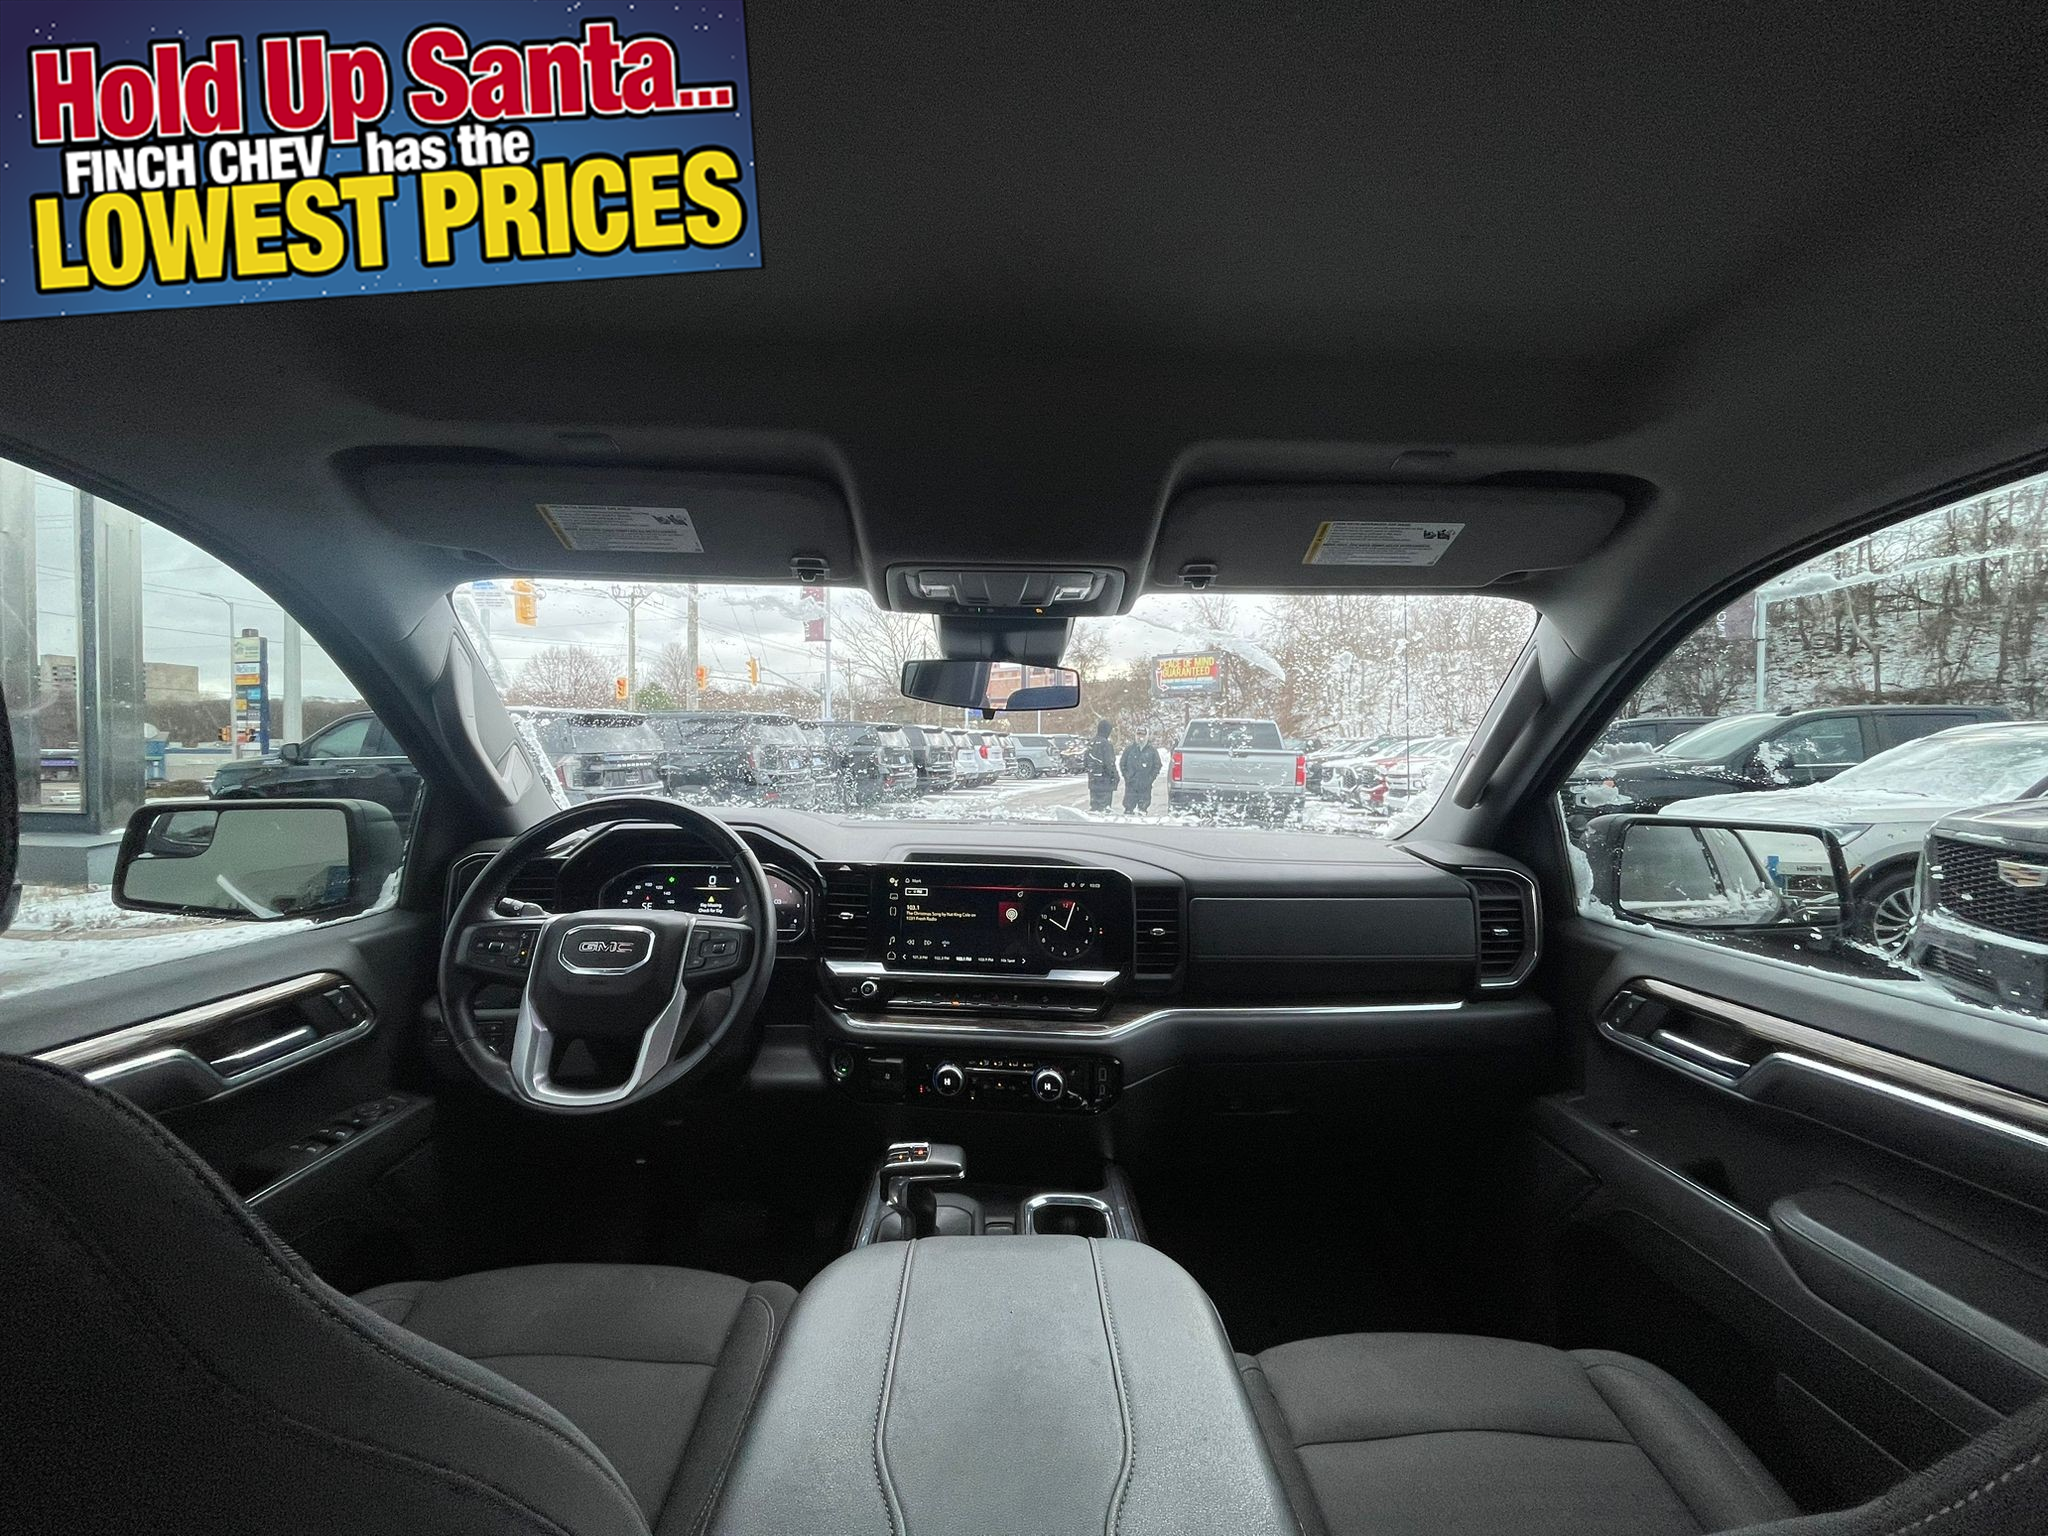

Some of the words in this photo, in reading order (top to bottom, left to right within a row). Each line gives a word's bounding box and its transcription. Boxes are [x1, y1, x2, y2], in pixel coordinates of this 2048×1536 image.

[1160, 660, 1182, 669] PEACE
[1183, 658, 1192, 667] OF
[1195, 657, 1214, 667] MIND
[1162, 667, 1211, 677] GUARANTEED
[641, 902, 653, 910] SE
[579, 941, 635, 953] GMC
